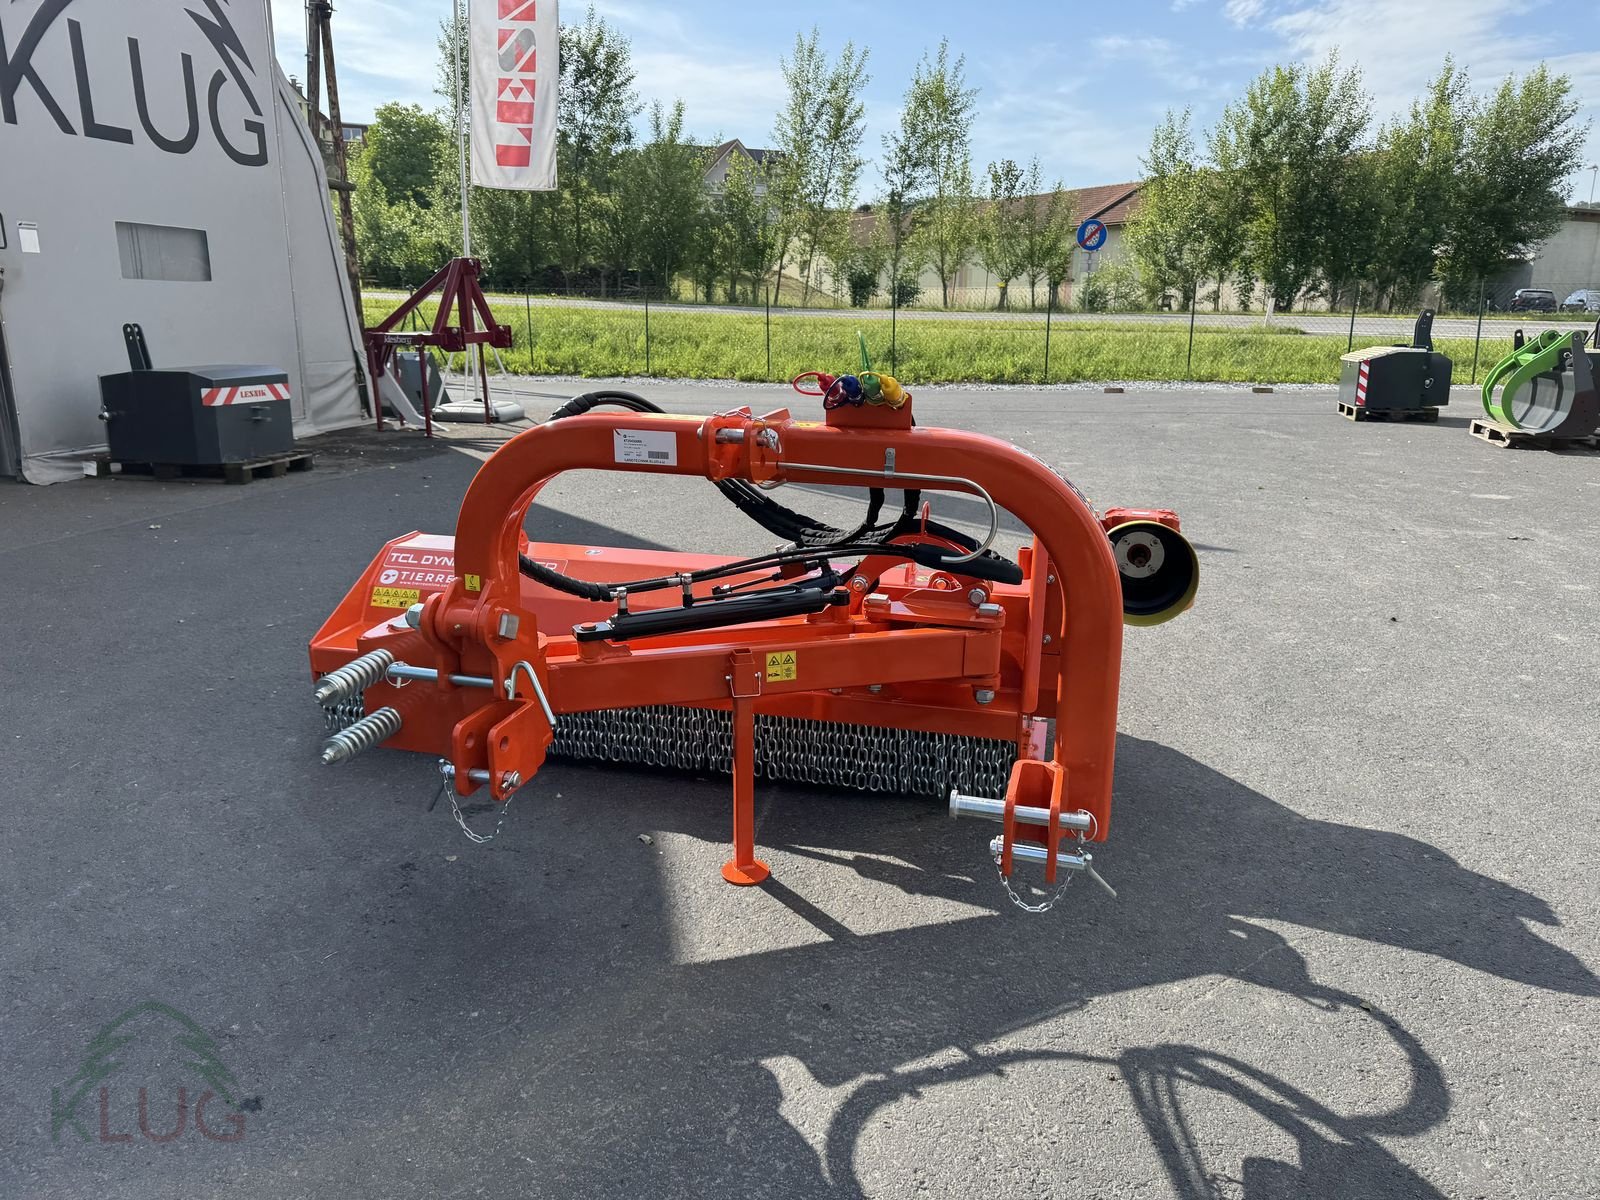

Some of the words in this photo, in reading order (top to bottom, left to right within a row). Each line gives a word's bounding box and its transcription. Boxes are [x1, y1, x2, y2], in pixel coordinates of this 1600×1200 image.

[0, 16, 268, 167] KLUG
[390, 552, 418, 565] TCL
[421, 555, 455, 567] DYN
